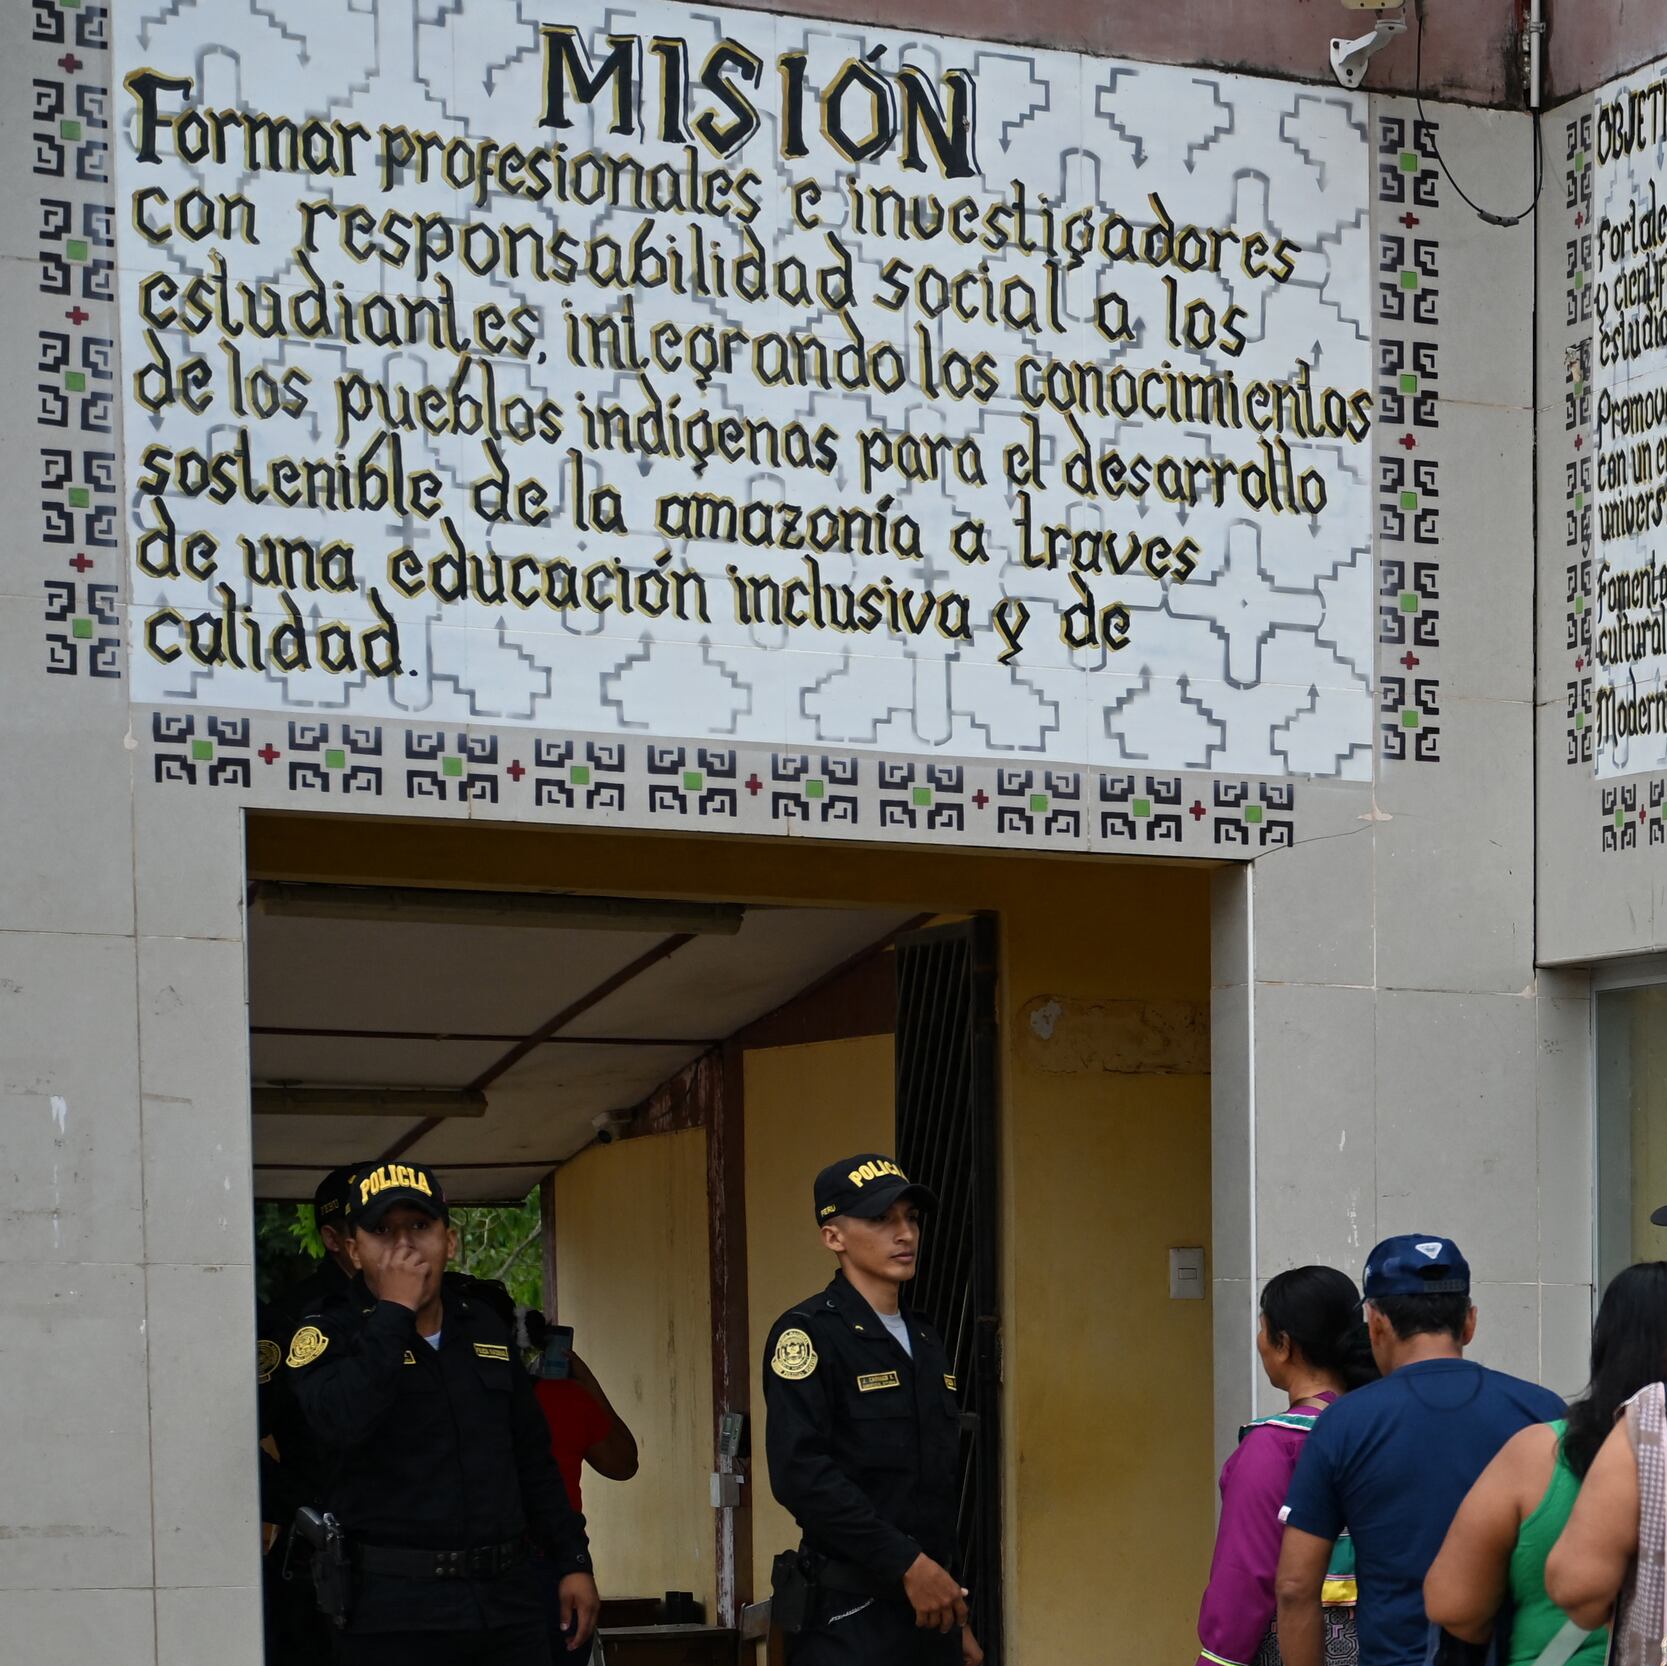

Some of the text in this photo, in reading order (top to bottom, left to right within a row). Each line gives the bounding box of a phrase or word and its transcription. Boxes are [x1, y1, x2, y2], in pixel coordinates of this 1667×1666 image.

[540, 23, 982, 177] MISIÓN
[124, 67, 1302, 284] Formar profesionales e investigadores
[132, 186, 1248, 358] con responsabilidad social a los
[1594, 282, 1608, 333] y
[133, 328, 1328, 517] de los pueblos indígenas para el desarrollo
[559, 297, 905, 397] integrando
[918, 322, 999, 403] los
[1015, 355, 1375, 444] conocimientos
[137, 427, 443, 521] sostenible
[470, 437, 551, 527] de
[567, 447, 627, 536] la
[949, 516, 990, 565] a
[1015, 491, 1202, 586] traves
[1597, 447, 1628, 493] con
[1630, 439, 1652, 486] un
[136, 495, 1132, 665] de una educación inclusiva y de
[143, 582, 419, 679] calidad.
[1596, 603, 1667, 667] cultural
[360, 1164, 433, 1206] POLICIA
[820, 1204, 836, 1217] PERU
